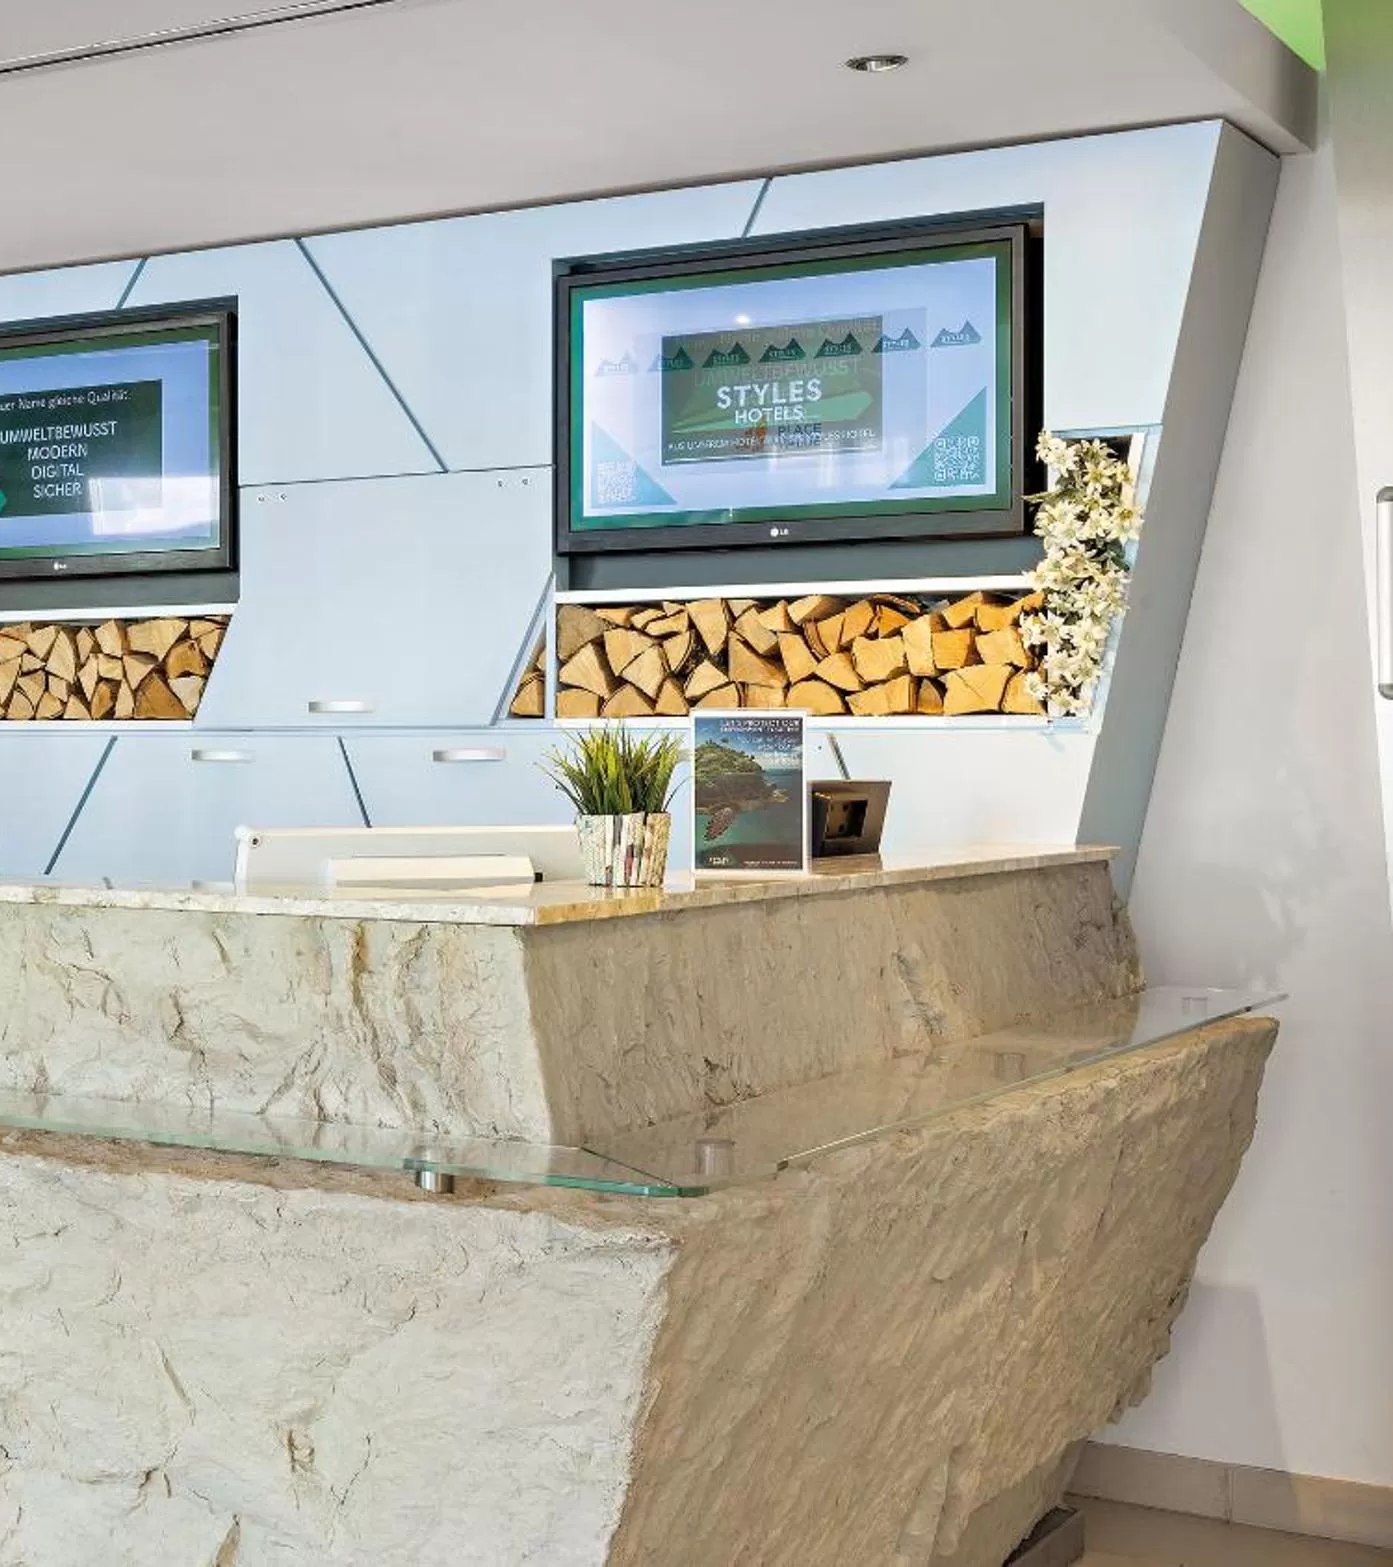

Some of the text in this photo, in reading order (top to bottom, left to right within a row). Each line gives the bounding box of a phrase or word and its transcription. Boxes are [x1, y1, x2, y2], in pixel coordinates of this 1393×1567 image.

[716, 378, 823, 410] STYLES
[735, 404, 804, 425] HOTELS
[0, 420, 118, 445] UMWELTBEWUSST
[27, 443, 88, 462] MODERN
[31, 463, 85, 480] DIGITAL
[33, 482, 83, 499] SICHER
